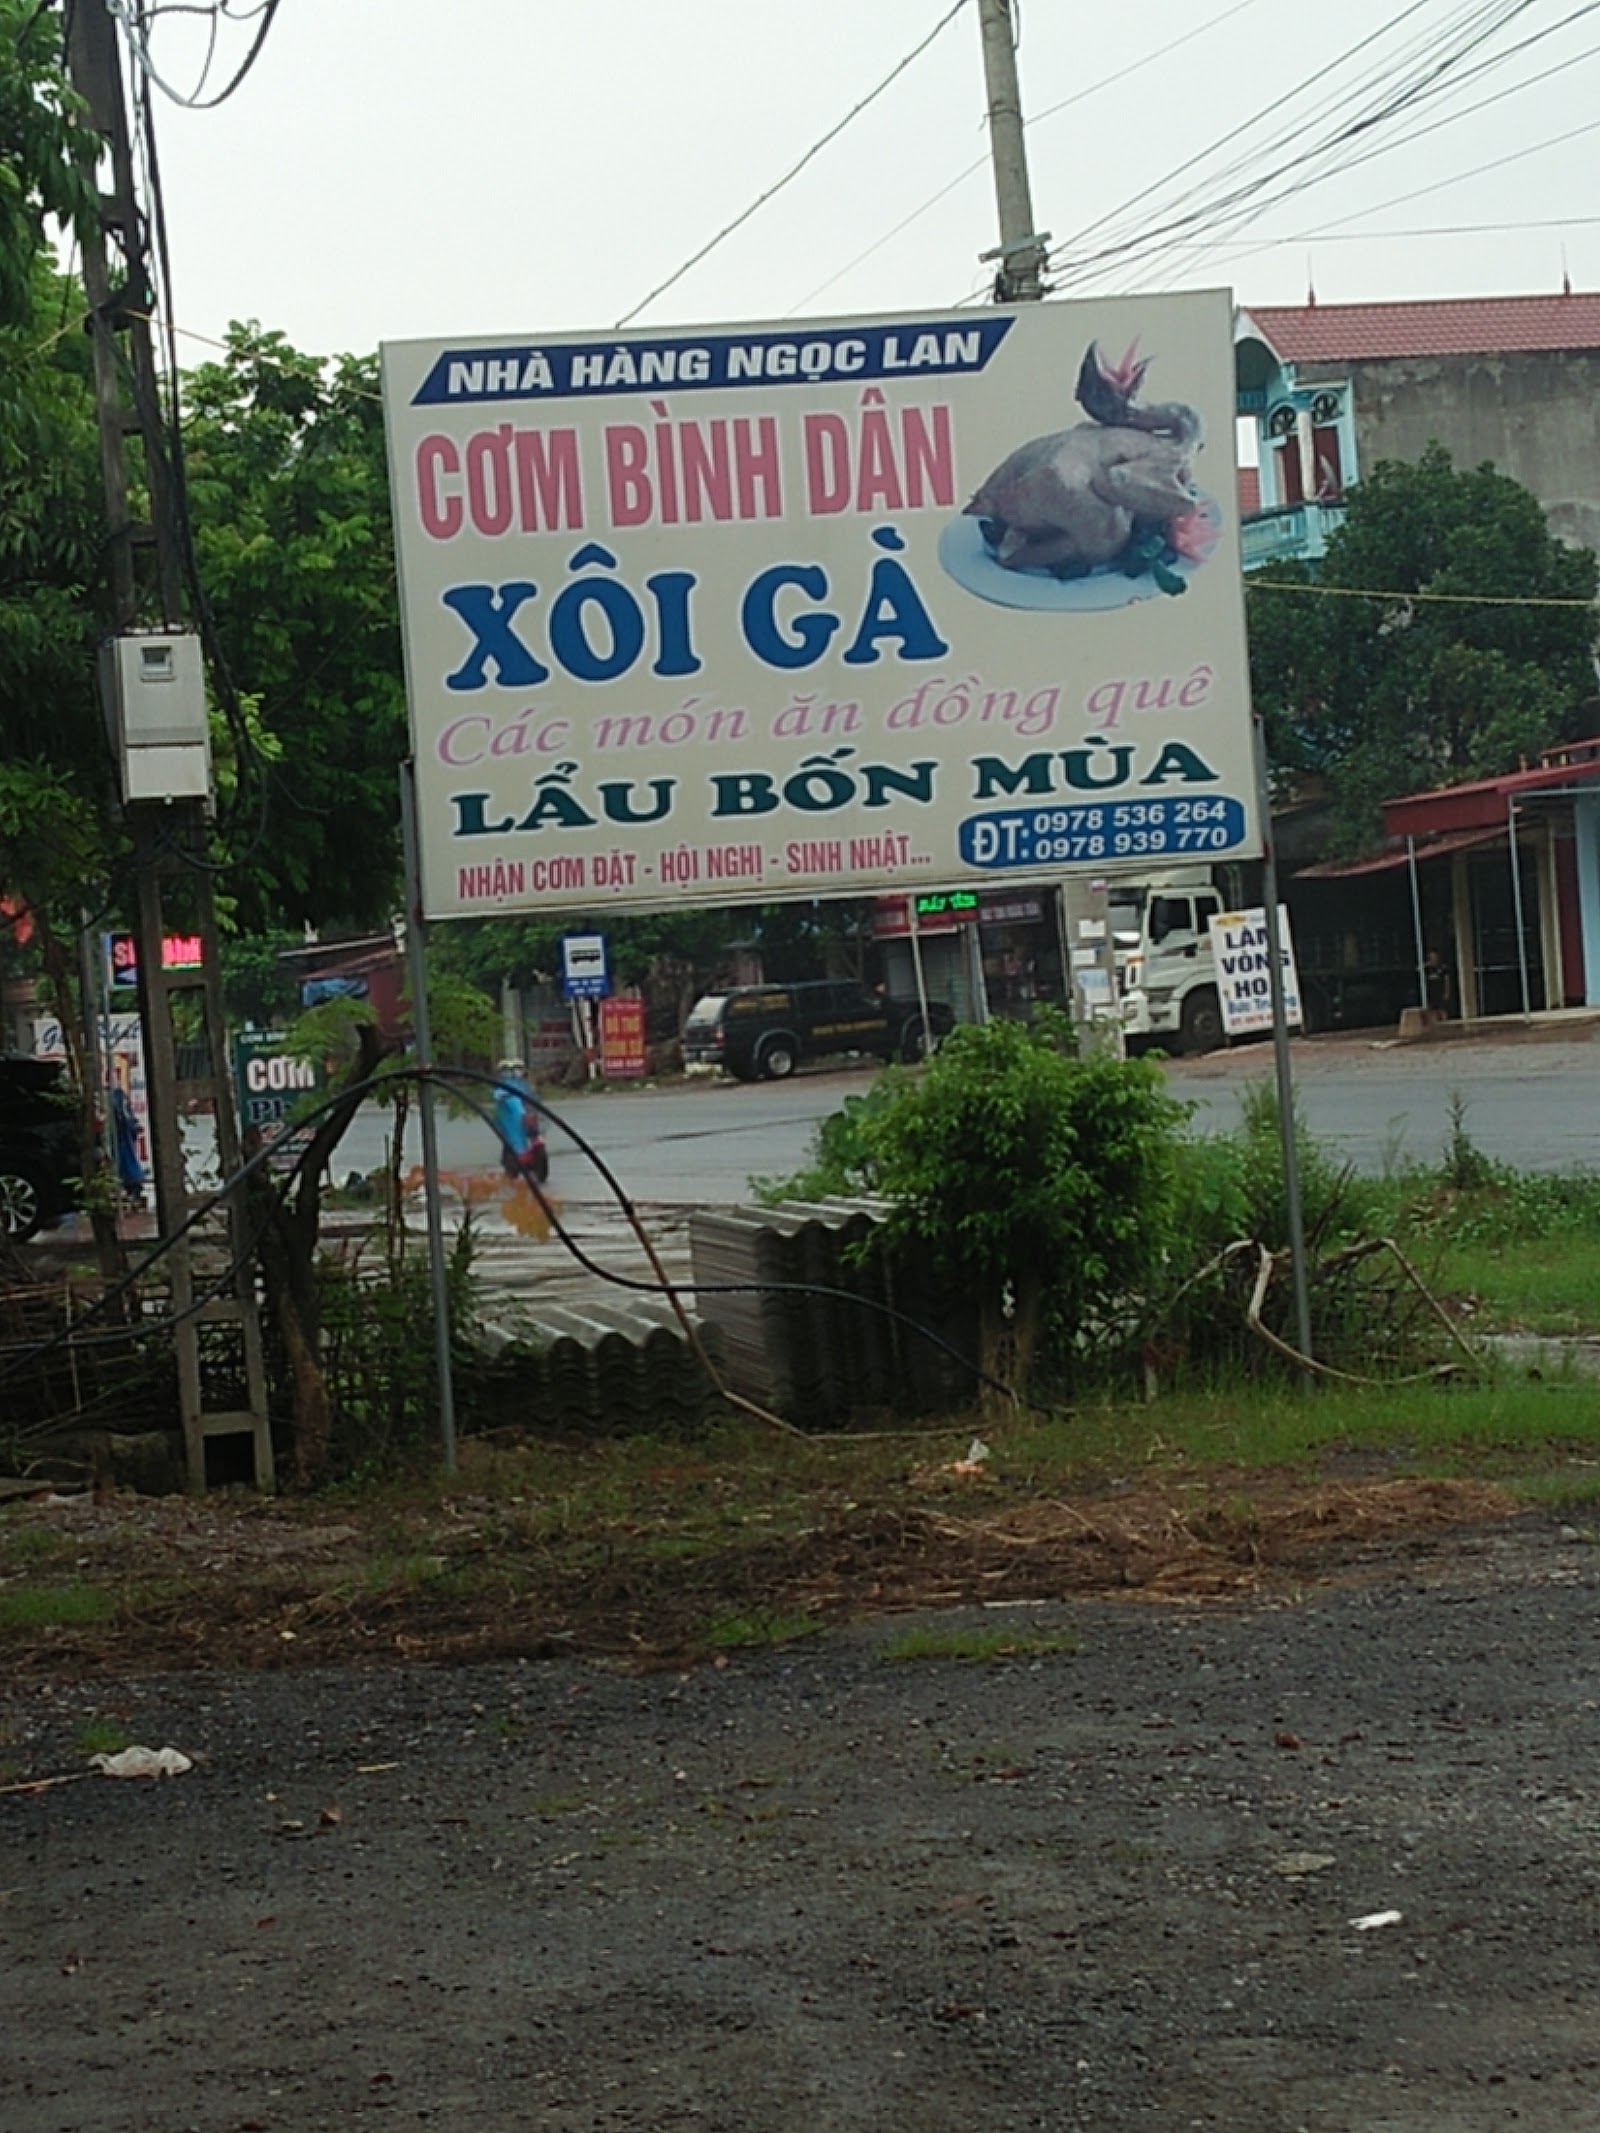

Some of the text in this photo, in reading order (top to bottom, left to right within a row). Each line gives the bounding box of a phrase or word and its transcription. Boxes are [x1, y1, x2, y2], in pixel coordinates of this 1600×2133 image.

[448, 330, 981, 394] NHÀ HÀNG NGỌC LAN
[416, 387, 954, 540] CƠM BÌNH DÂN
[442, 526, 949, 691] XÔI GÀ
[437, 707, 570, 766] Các
[594, 698, 749, 749] món
[772, 694, 862, 738] ăn
[1087, 665, 1214, 729] quê
[452, 736, 1220, 836] LẨU BỐN MÙA
[1033, 808, 1104, 834] 0978
[1112, 804, 1165, 827] 536
[1173, 800, 1227, 823] 264
[459, 857, 525, 902] NHẬN
[533, 856, 585, 891] CƠM
[593, 849, 636, 892] ĐẶT
[660, 844, 699, 888] HỘI
[706, 845, 763, 882] NGHỊ
[787, 841, 842, 873] SINH
[1035, 826, 1228, 860] 0978 939 770
[1234, 977, 1285, 998] HO
